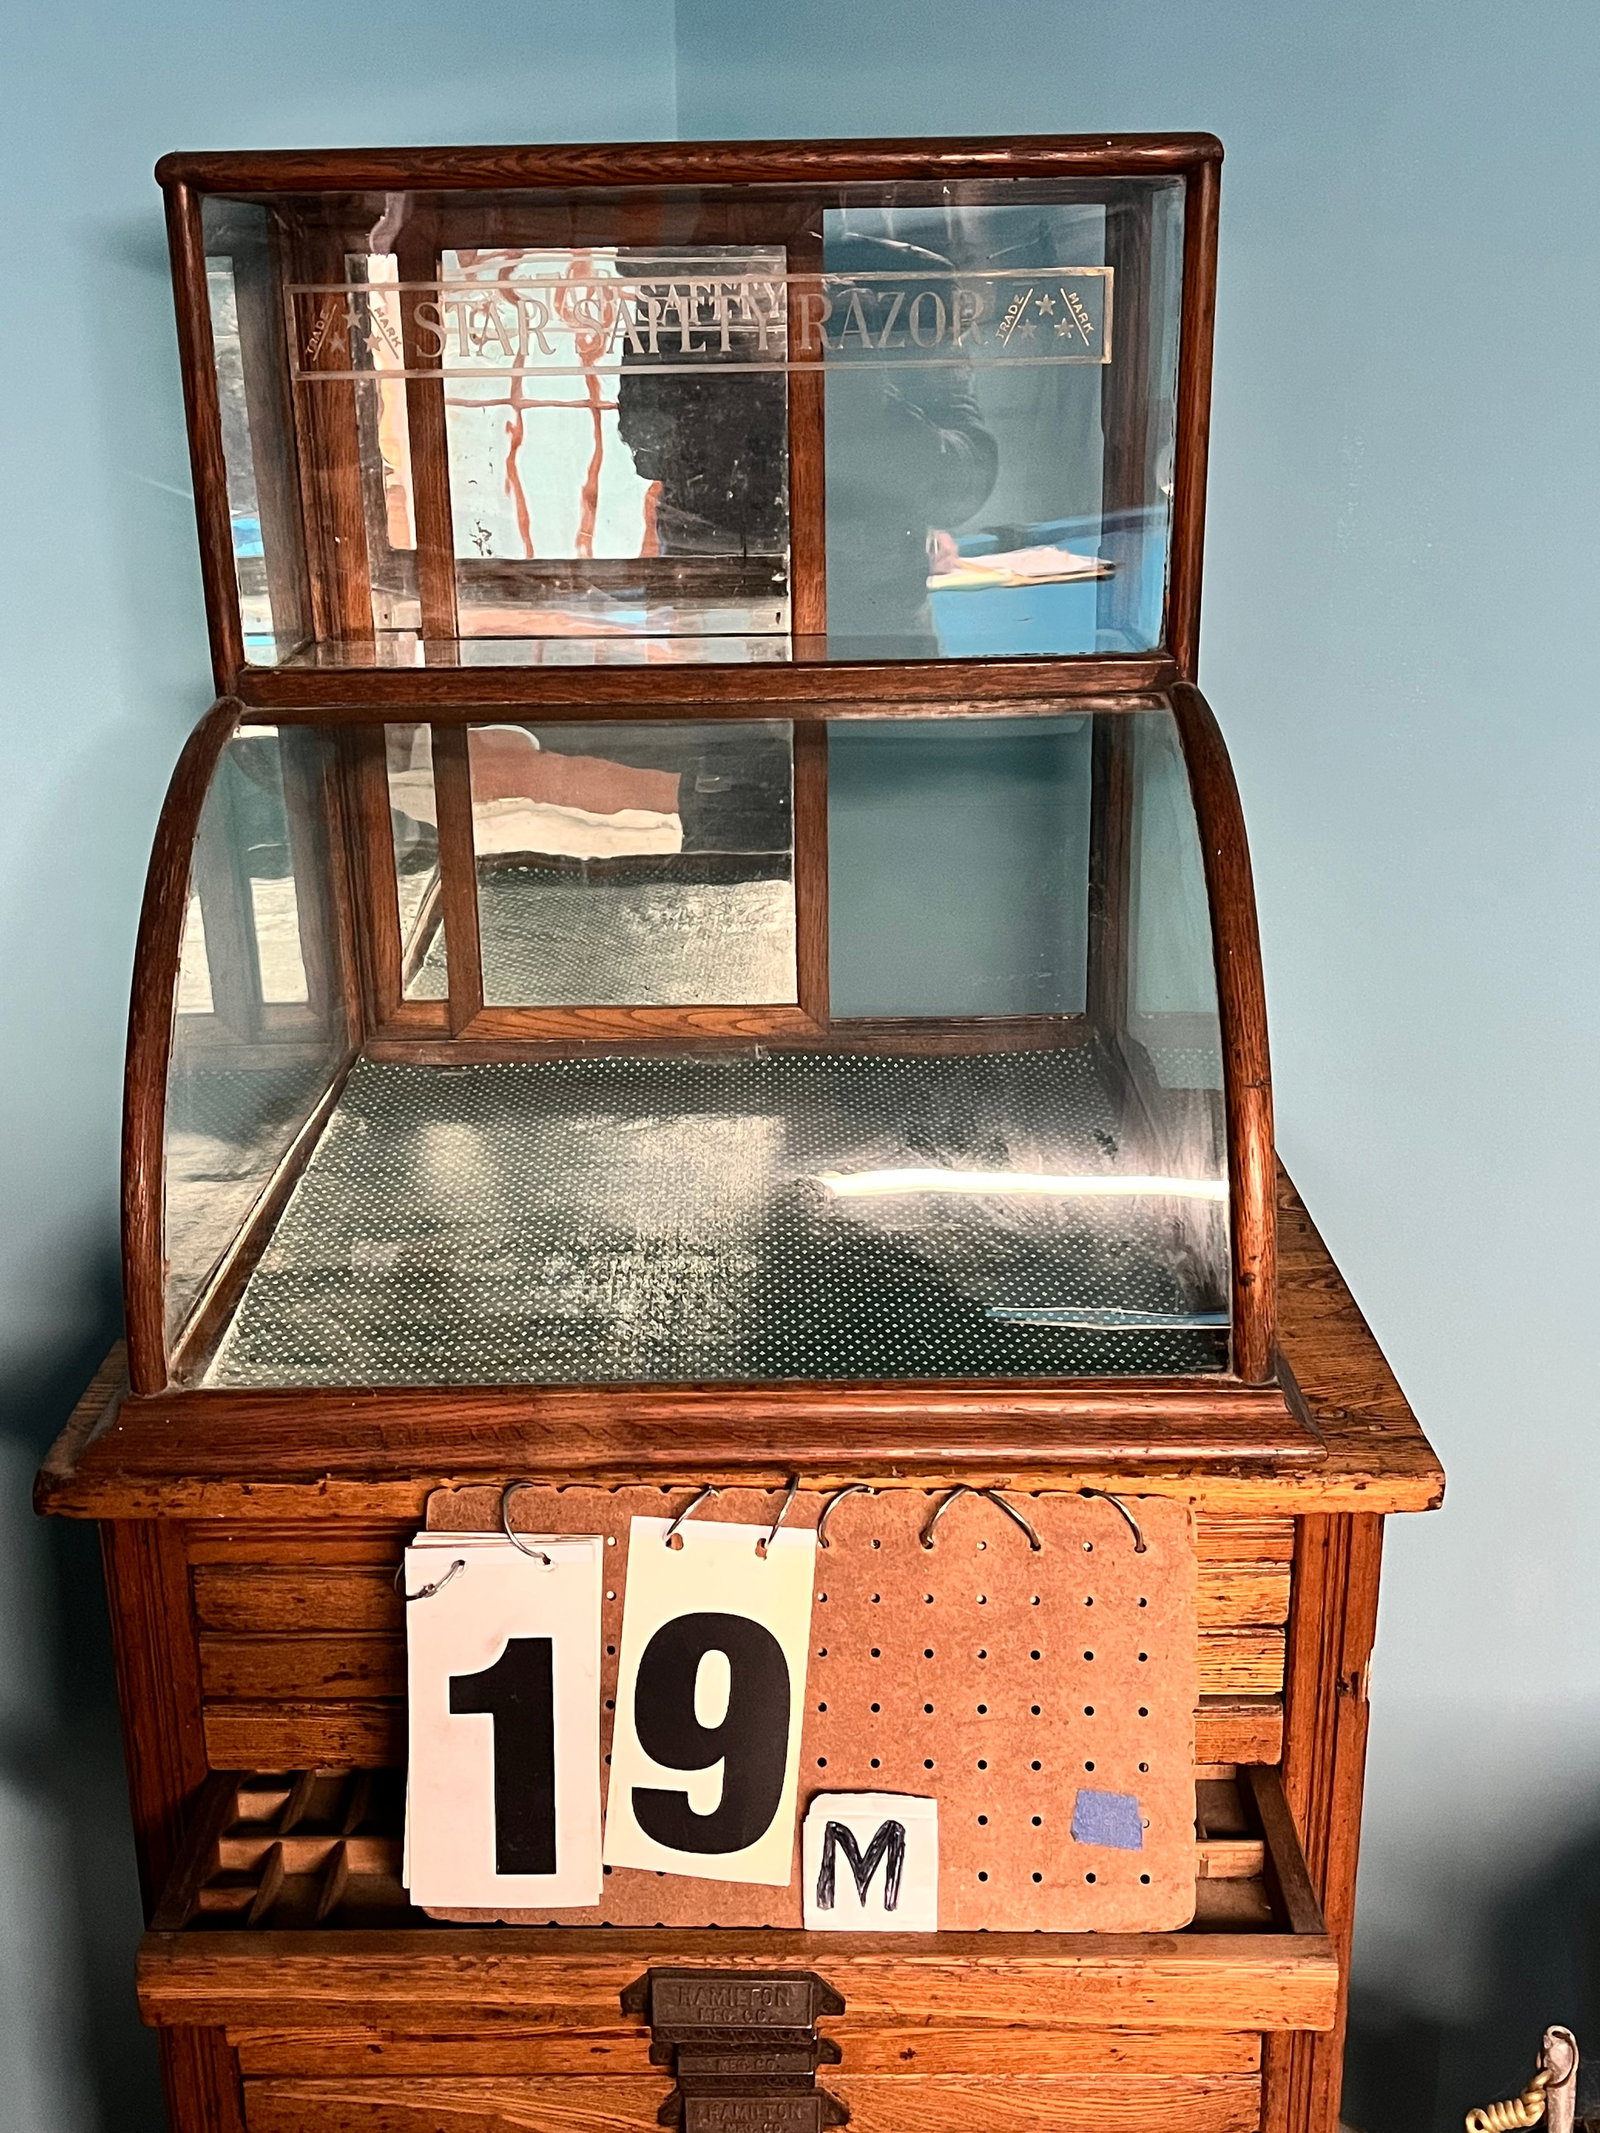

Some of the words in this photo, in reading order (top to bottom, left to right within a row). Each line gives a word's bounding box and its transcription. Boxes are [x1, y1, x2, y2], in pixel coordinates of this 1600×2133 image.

[304, 309, 330, 354] TRADE
[374, 307, 402, 348] MARK
[413, 299, 561, 359] STAR
[798, 290, 987, 350] RAZOR
[995, 293, 1025, 339] TRADE
[1068, 292, 1095, 334] MARK
[817, 1820, 906, 1911] M
[678, 1986, 791, 2007] HAMILTON
[708, 2102, 802, 2120] HAMILTON
